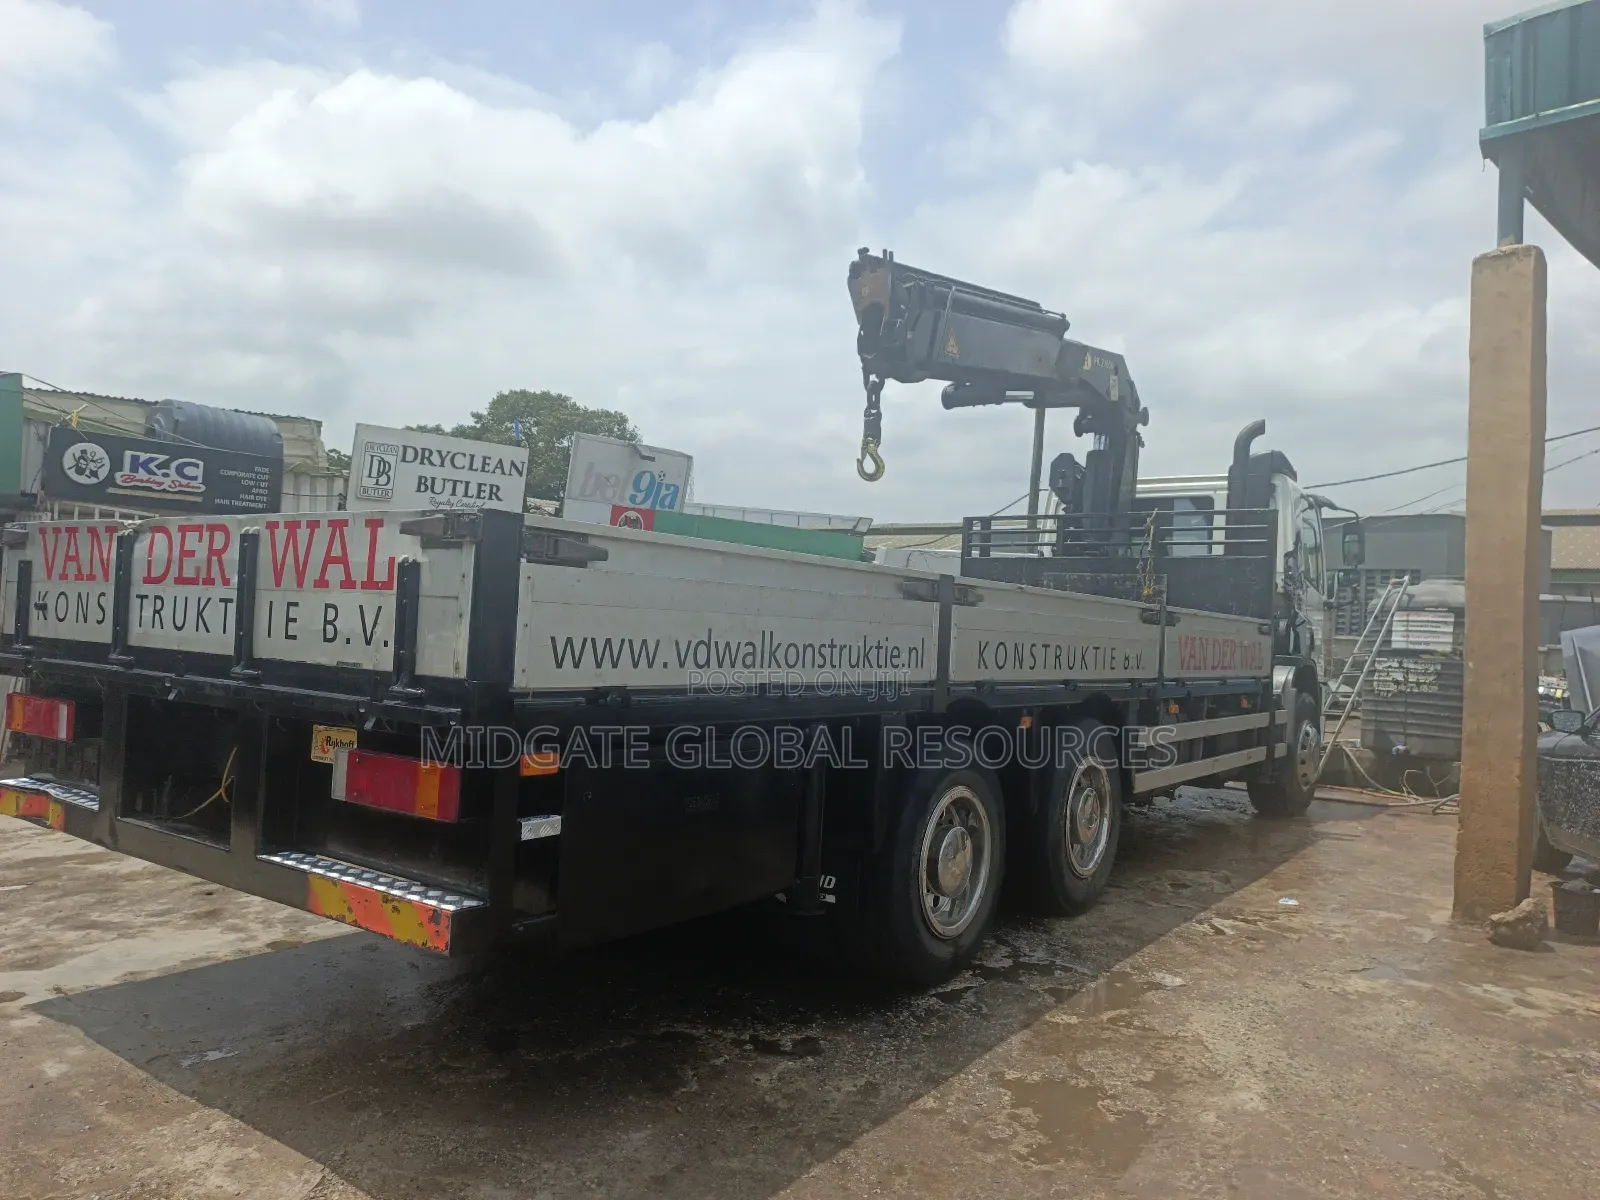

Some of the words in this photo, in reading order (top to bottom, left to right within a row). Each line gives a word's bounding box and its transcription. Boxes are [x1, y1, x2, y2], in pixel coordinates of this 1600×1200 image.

[129, 454, 200, 481] K.C
[220, 469, 256, 479] CORPORATE
[254, 466, 270, 474] FADE
[366, 454, 391, 486] DB
[400, 444, 525, 477] DRYCLEAN
[362, 487, 391, 498] BUTLER
[415, 475, 503, 501] BUTLER
[231, 500, 267, 509] TREATMENT
[38, 526, 118, 582] VAN
[142, 523, 231, 586] DER
[265, 519, 396, 591] WAL
[550, 628, 926, 670] www.vdwalkonstruktie.nl
[977, 641, 1117, 671] KONSTRUKTIE
[1177, 634, 1207, 671] VAN
[1210, 638, 1236, 671] DER
[1239, 640, 1264, 671] WAL
[325, 735, 355, 750] Rijkhoff
